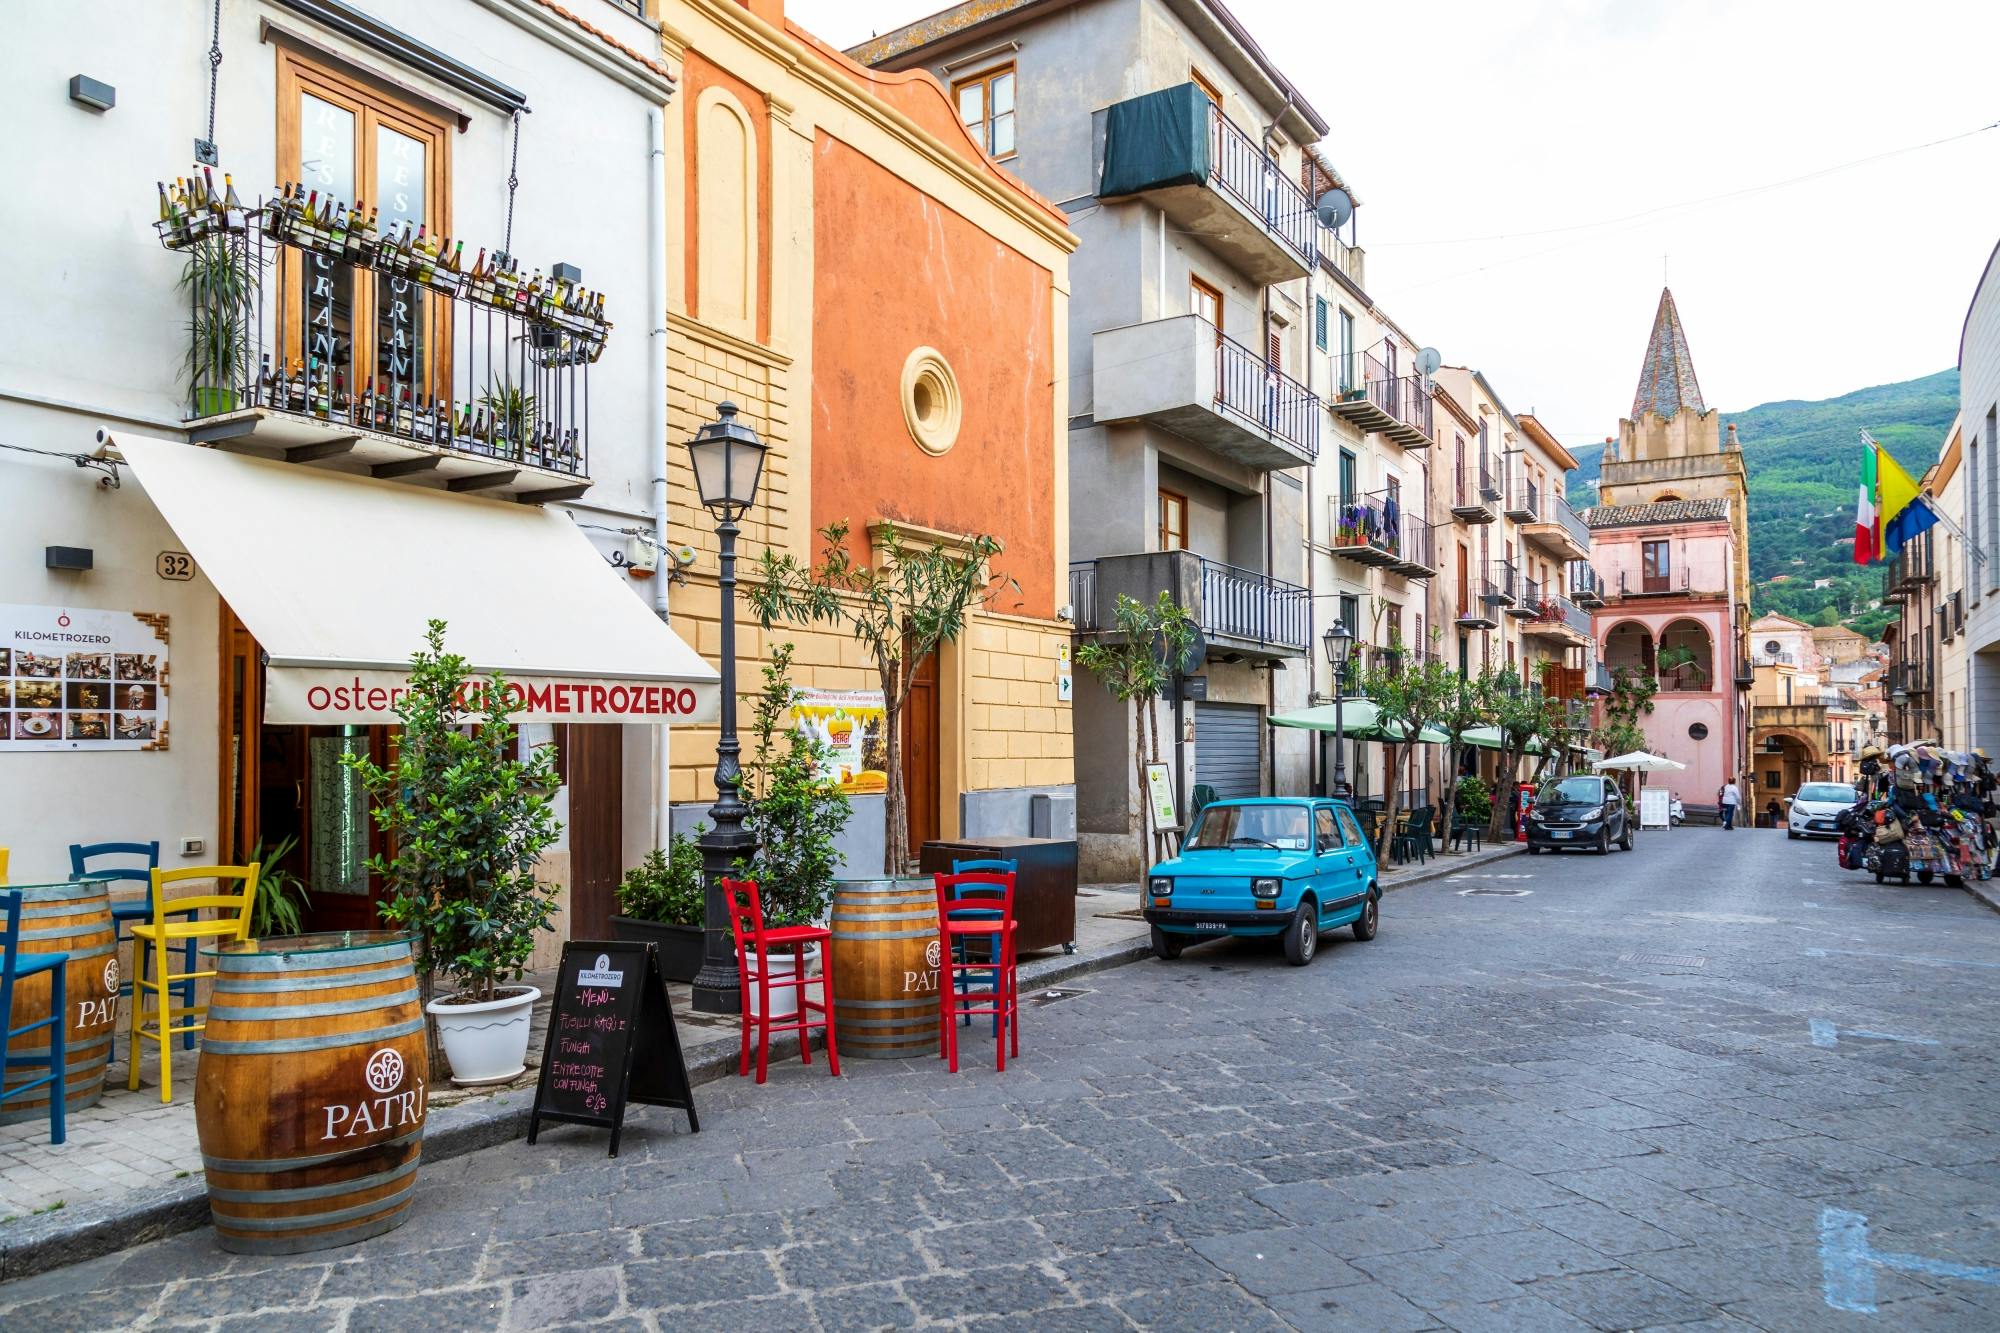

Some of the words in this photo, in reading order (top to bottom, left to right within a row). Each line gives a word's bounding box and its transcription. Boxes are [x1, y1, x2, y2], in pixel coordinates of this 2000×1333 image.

[164, 555, 189, 576] 32
[14, 630, 111, 644] KILOMETROZERO
[580, 972, 622, 981] KILOMETROZERO
[902, 969, 941, 992] PAT
[74, 993, 120, 1029] PAT
[320, 1077, 424, 1140] PATRÌ
